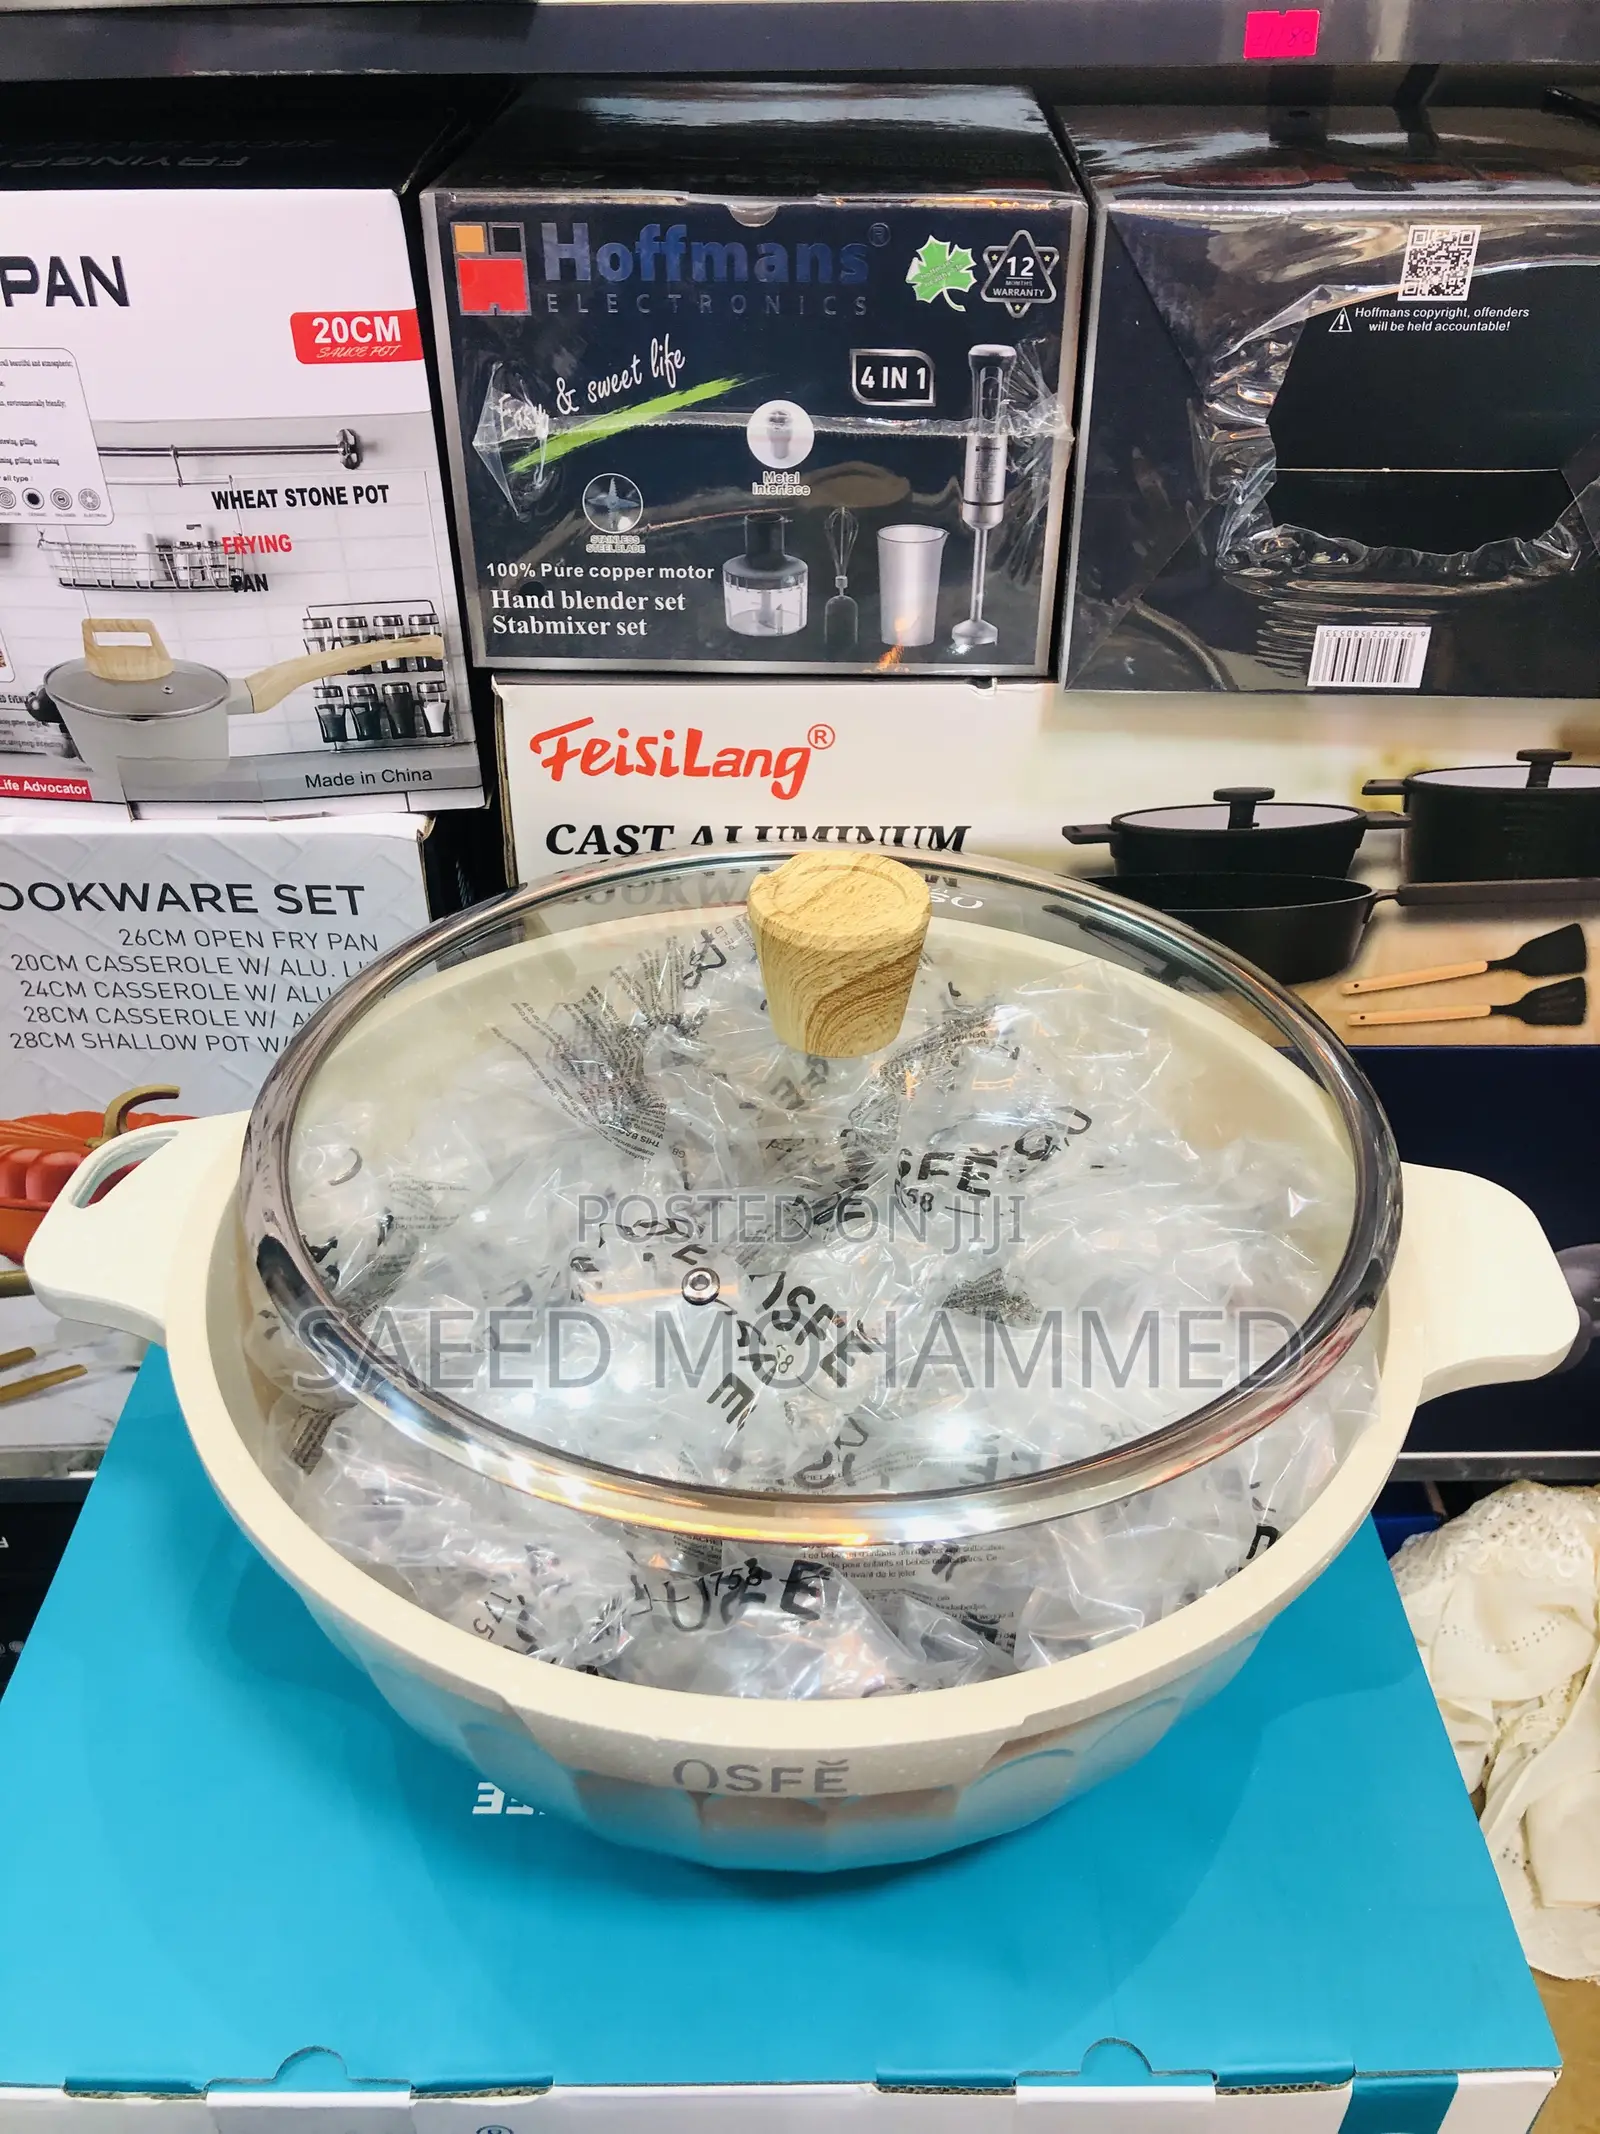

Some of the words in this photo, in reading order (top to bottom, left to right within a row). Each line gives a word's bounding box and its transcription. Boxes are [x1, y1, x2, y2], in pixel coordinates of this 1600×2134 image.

[541, 222, 869, 282] Hoffmans
[1006, 256, 1034, 277] 12
[0, 255, 131, 308] PAN
[993, 288, 1045, 297] WARRANTY
[547, 293, 867, 316] ELECTRONICS
[1355, 307, 1410, 318] Hoffmans
[1412, 307, 1471, 320] copyright,
[1474, 307, 1529, 318] offenders
[312, 315, 401, 344] 20CM
[1369, 321, 1389, 332] will
[1390, 321, 1405, 332] be
[1407, 321, 1432, 332] held
[1435, 321, 1510, 332] accountable!
[317, 345, 368, 359] SAUCE
[370, 344, 402, 358] POT
[587, 354, 642, 403] sweet
[650, 333, 685, 389] life
[860, 366, 875, 389] 4
[882, 366, 907, 389] IN
[916, 367, 926, 389] 1
[762, 470, 800, 484] Metal
[211, 487, 279, 510] WHEAT
[285, 486, 348, 508] STONE
[354, 484, 389, 504] POT
[752, 482, 810, 496] interface
[222, 534, 292, 555] FRYING
[590, 535, 640, 544] STAINLESS
[231, 573, 269, 594] PAN
[486, 563, 536, 578] 100%
[541, 563, 584, 578] Pure
[589, 566, 652, 583] copper
[659, 566, 714, 580] motor
[490, 589, 554, 610] Hand
[562, 590, 649, 611] blender
[655, 593, 686, 611] set
[493, 615, 610, 636] Stabmixer
[617, 618, 648, 636] set
[529, 716, 811, 800] FeisiLang
[23, 780, 87, 795] Advocator
[305, 771, 355, 789] Made
[360, 770, 374, 786] in
[380, 768, 433, 785] China
[546, 823, 676, 856] CAST
[0, 881, 258, 914] OOKWARE
[276, 884, 365, 916] SET
[119, 928, 187, 948] 26CM
[194, 929, 264, 949] OPEN
[273, 931, 318, 951] FRY
[328, 932, 378, 951] PAN
[11, 953, 78, 972] 20CM
[85, 954, 231, 976] CASSEROLE
[238, 956, 269, 976] W/
[280, 958, 336, 978] ALU.
[20, 980, 89, 999] 24CM
[94, 981, 238, 1003] CASSEROLE
[245, 983, 277, 1003] W/
[23, 1005, 89, 1024] 28CM
[95, 1006, 241, 1028] CASSEROLE
[246, 1009, 276, 1029] W/
[9, 1031, 75, 1050] 28CM
[82, 1032, 197, 1051] SHALLOW
[207, 1034, 251, 1053] POT
